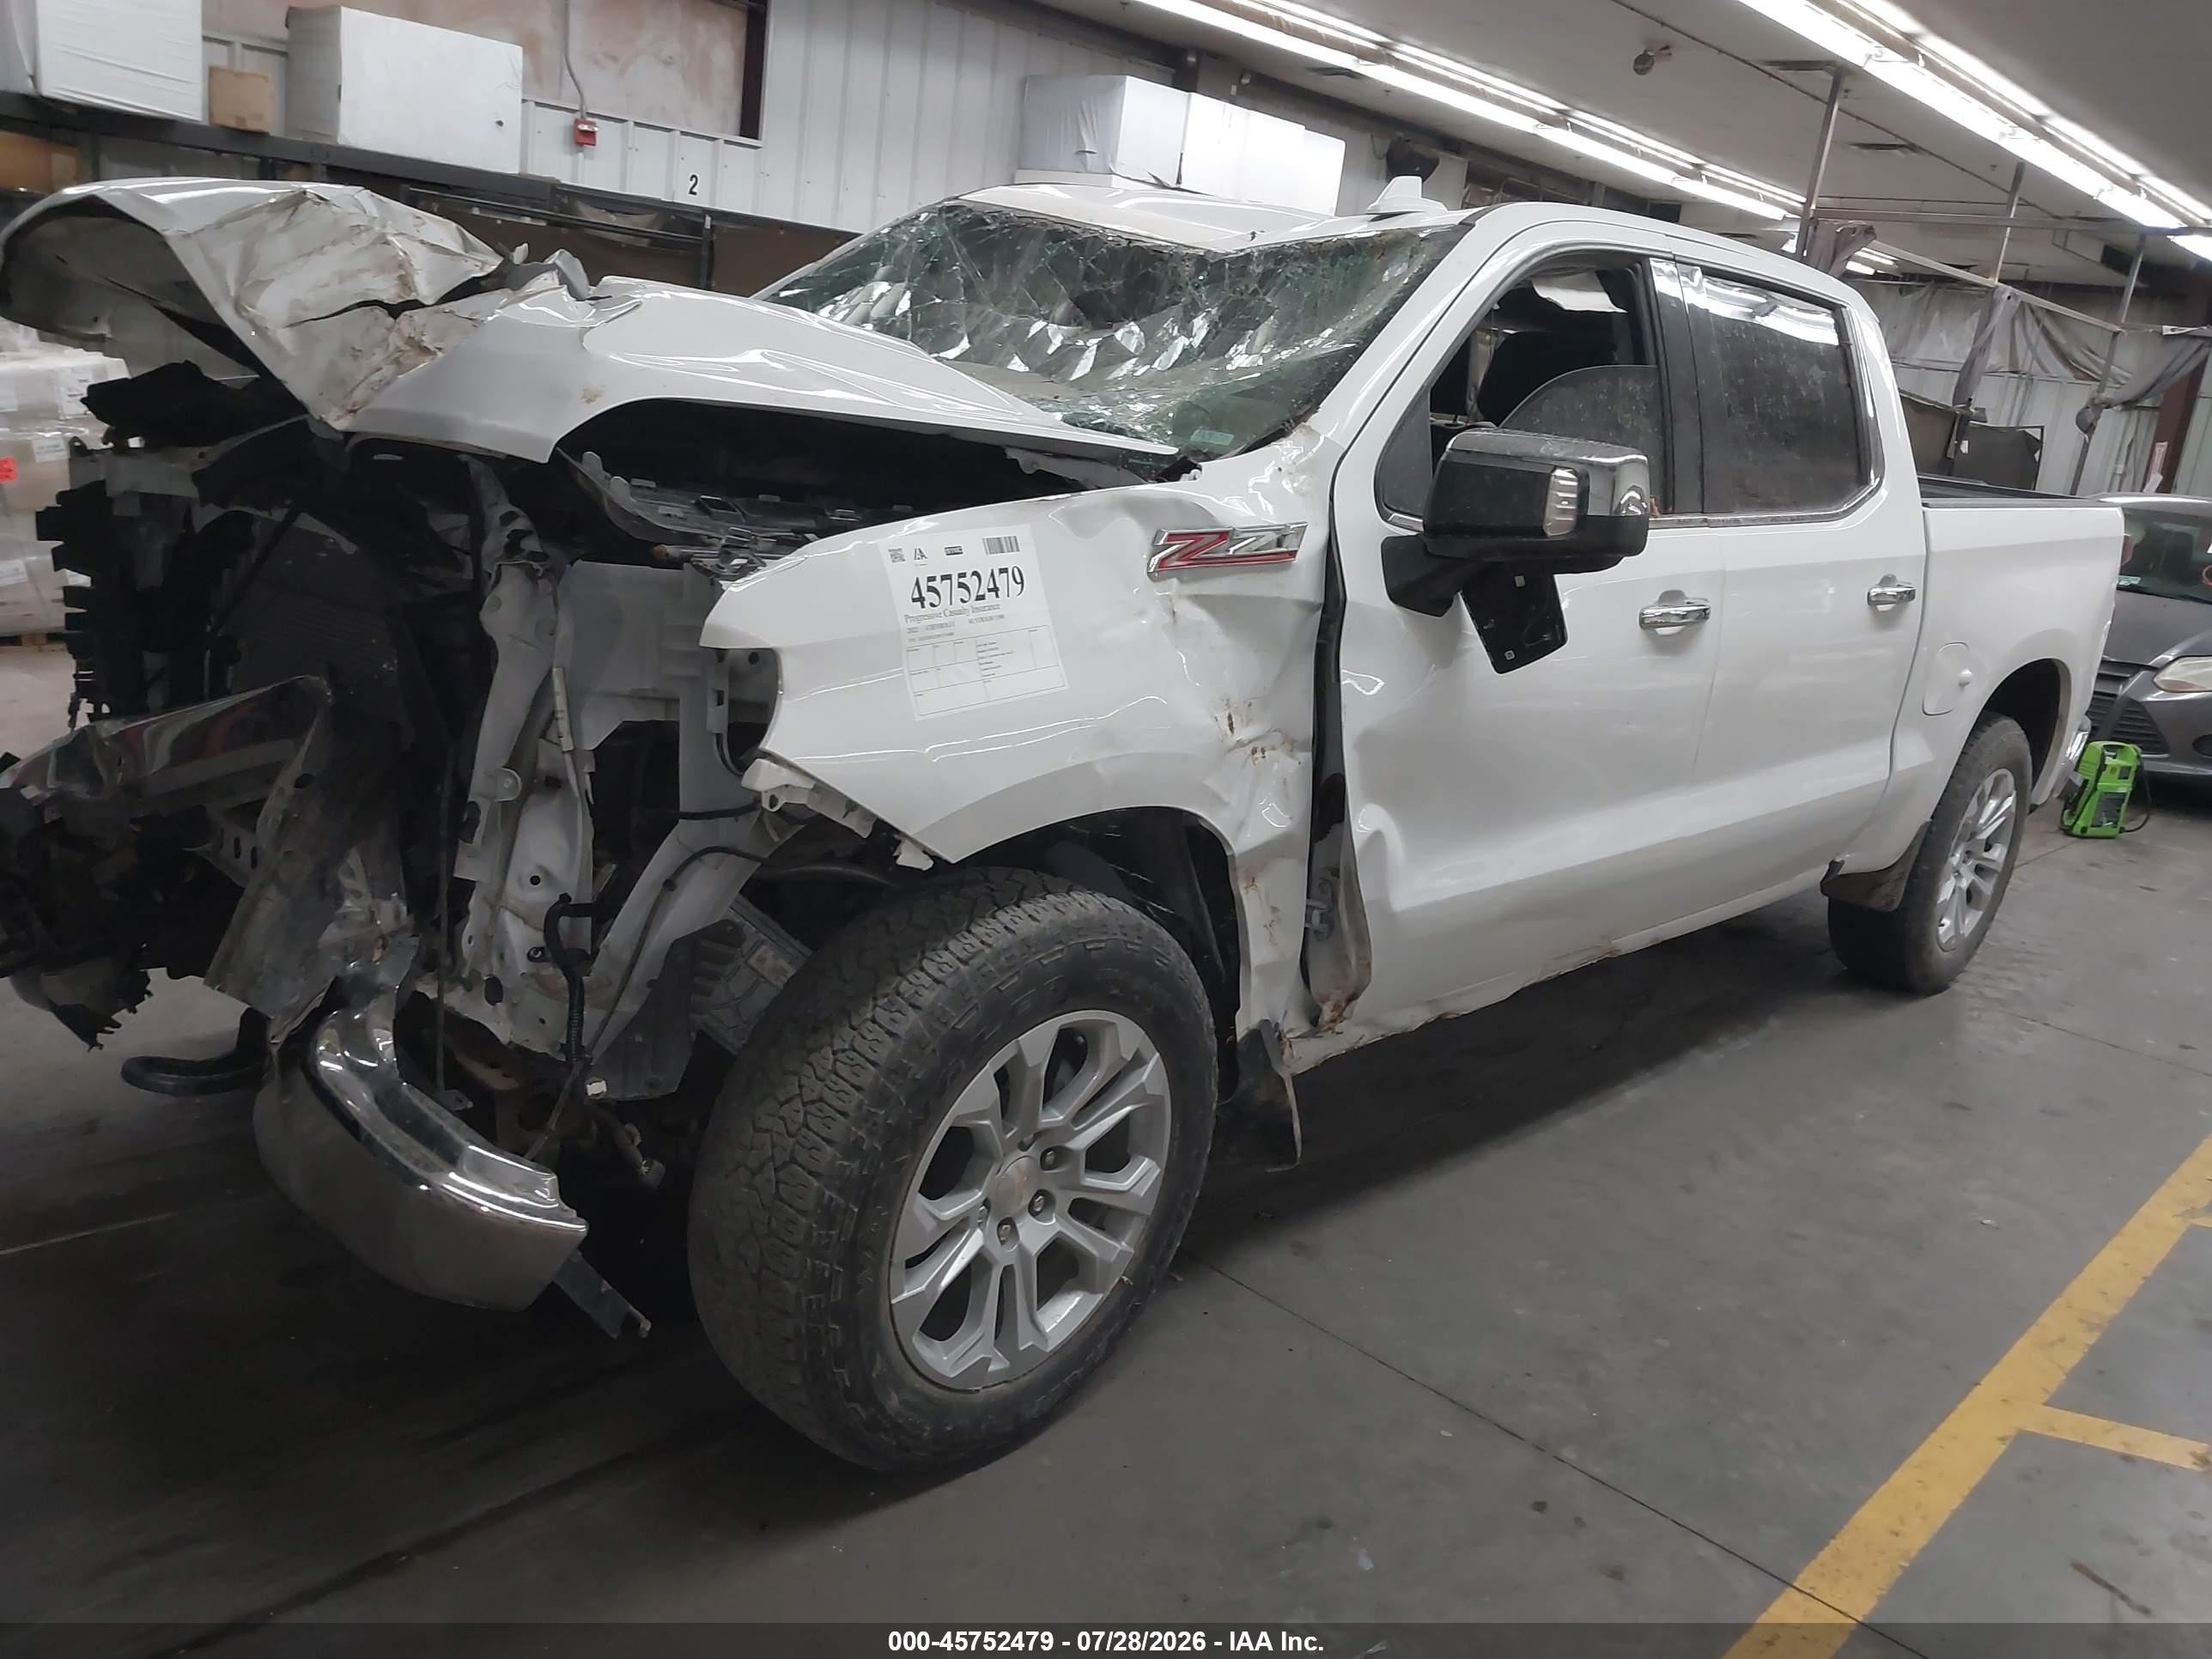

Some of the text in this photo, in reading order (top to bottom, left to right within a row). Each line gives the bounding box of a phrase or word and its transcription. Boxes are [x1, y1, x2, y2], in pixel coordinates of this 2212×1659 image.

[689, 174, 698, 196] 2
[1147, 521, 1308, 574] Z71
[911, 566, 1024, 609] 45752479
